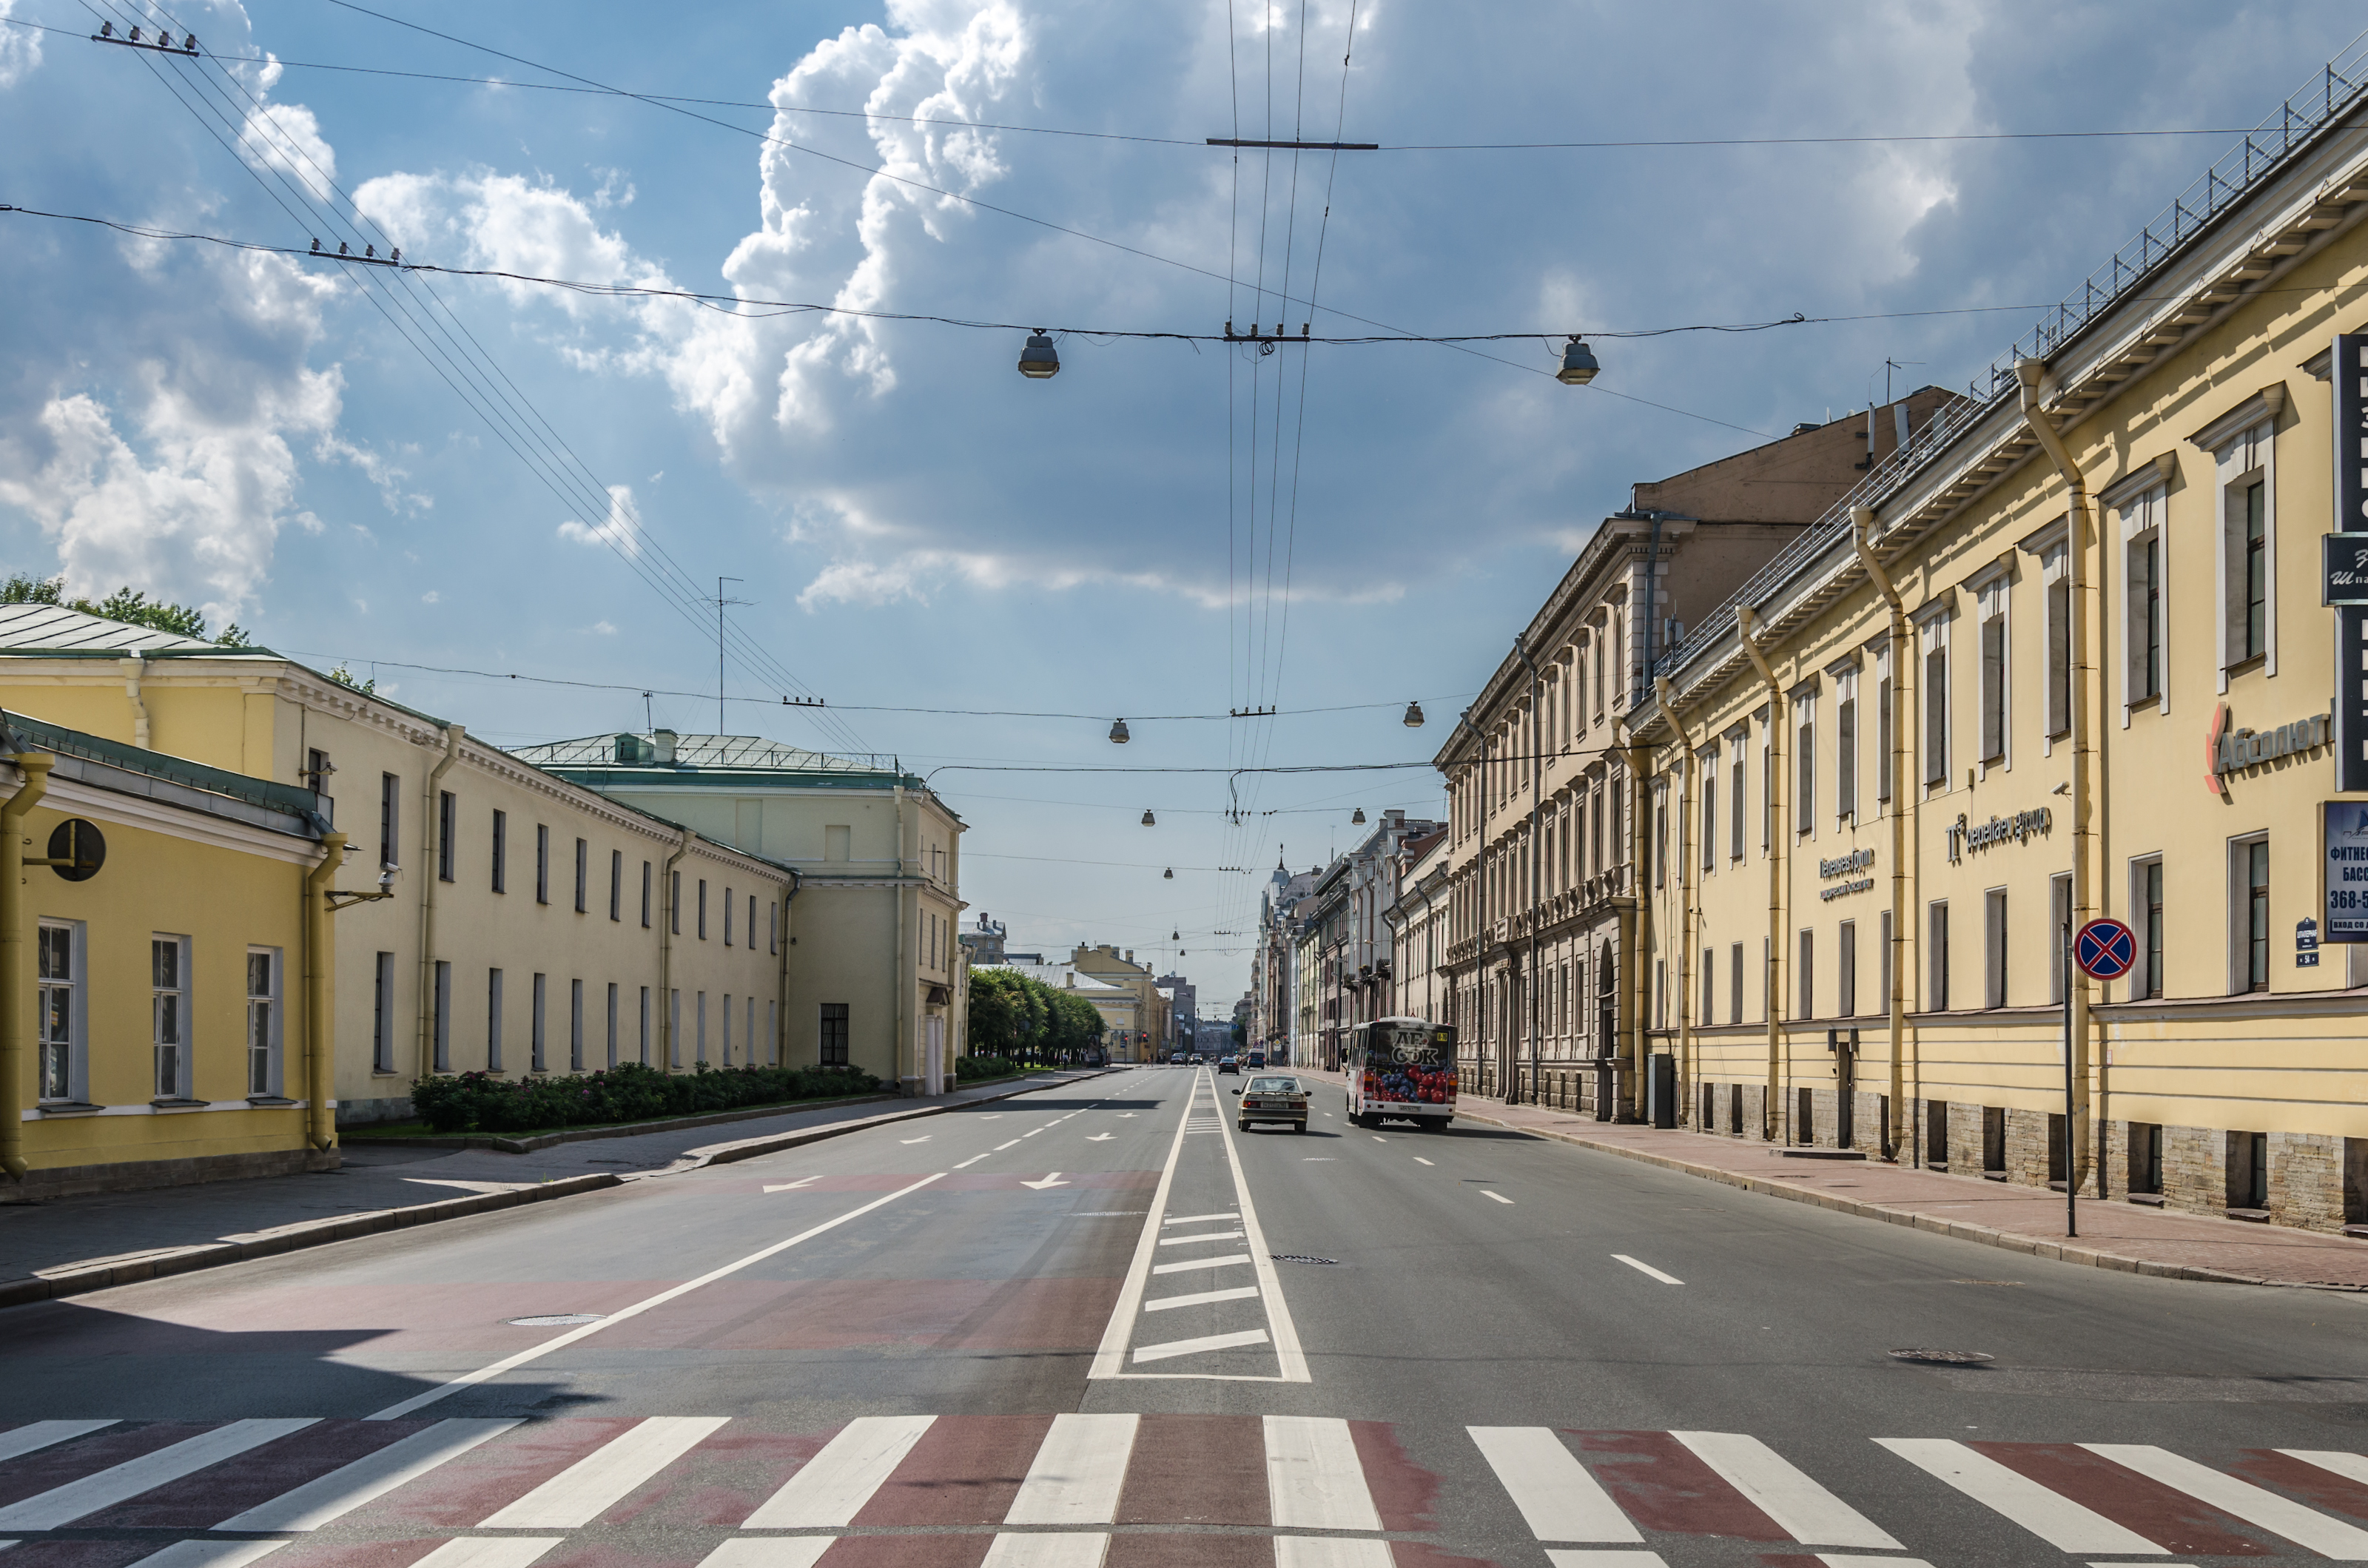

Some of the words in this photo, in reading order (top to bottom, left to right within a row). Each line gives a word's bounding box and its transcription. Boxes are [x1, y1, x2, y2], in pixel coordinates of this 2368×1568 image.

[2218, 713, 2329, 773] Абсолют
[1967, 815, 2014, 853] pepeliaev
[2015, 807, 2048, 841] group
[1820, 855, 1851, 878] Пепеляев
[2343, 867, 2368, 881] БАСС
[2330, 890, 2368, 909] 368-5
[2333, 921, 2352, 929] ВХОД
[1393, 1048, 1437, 1065] СОК
